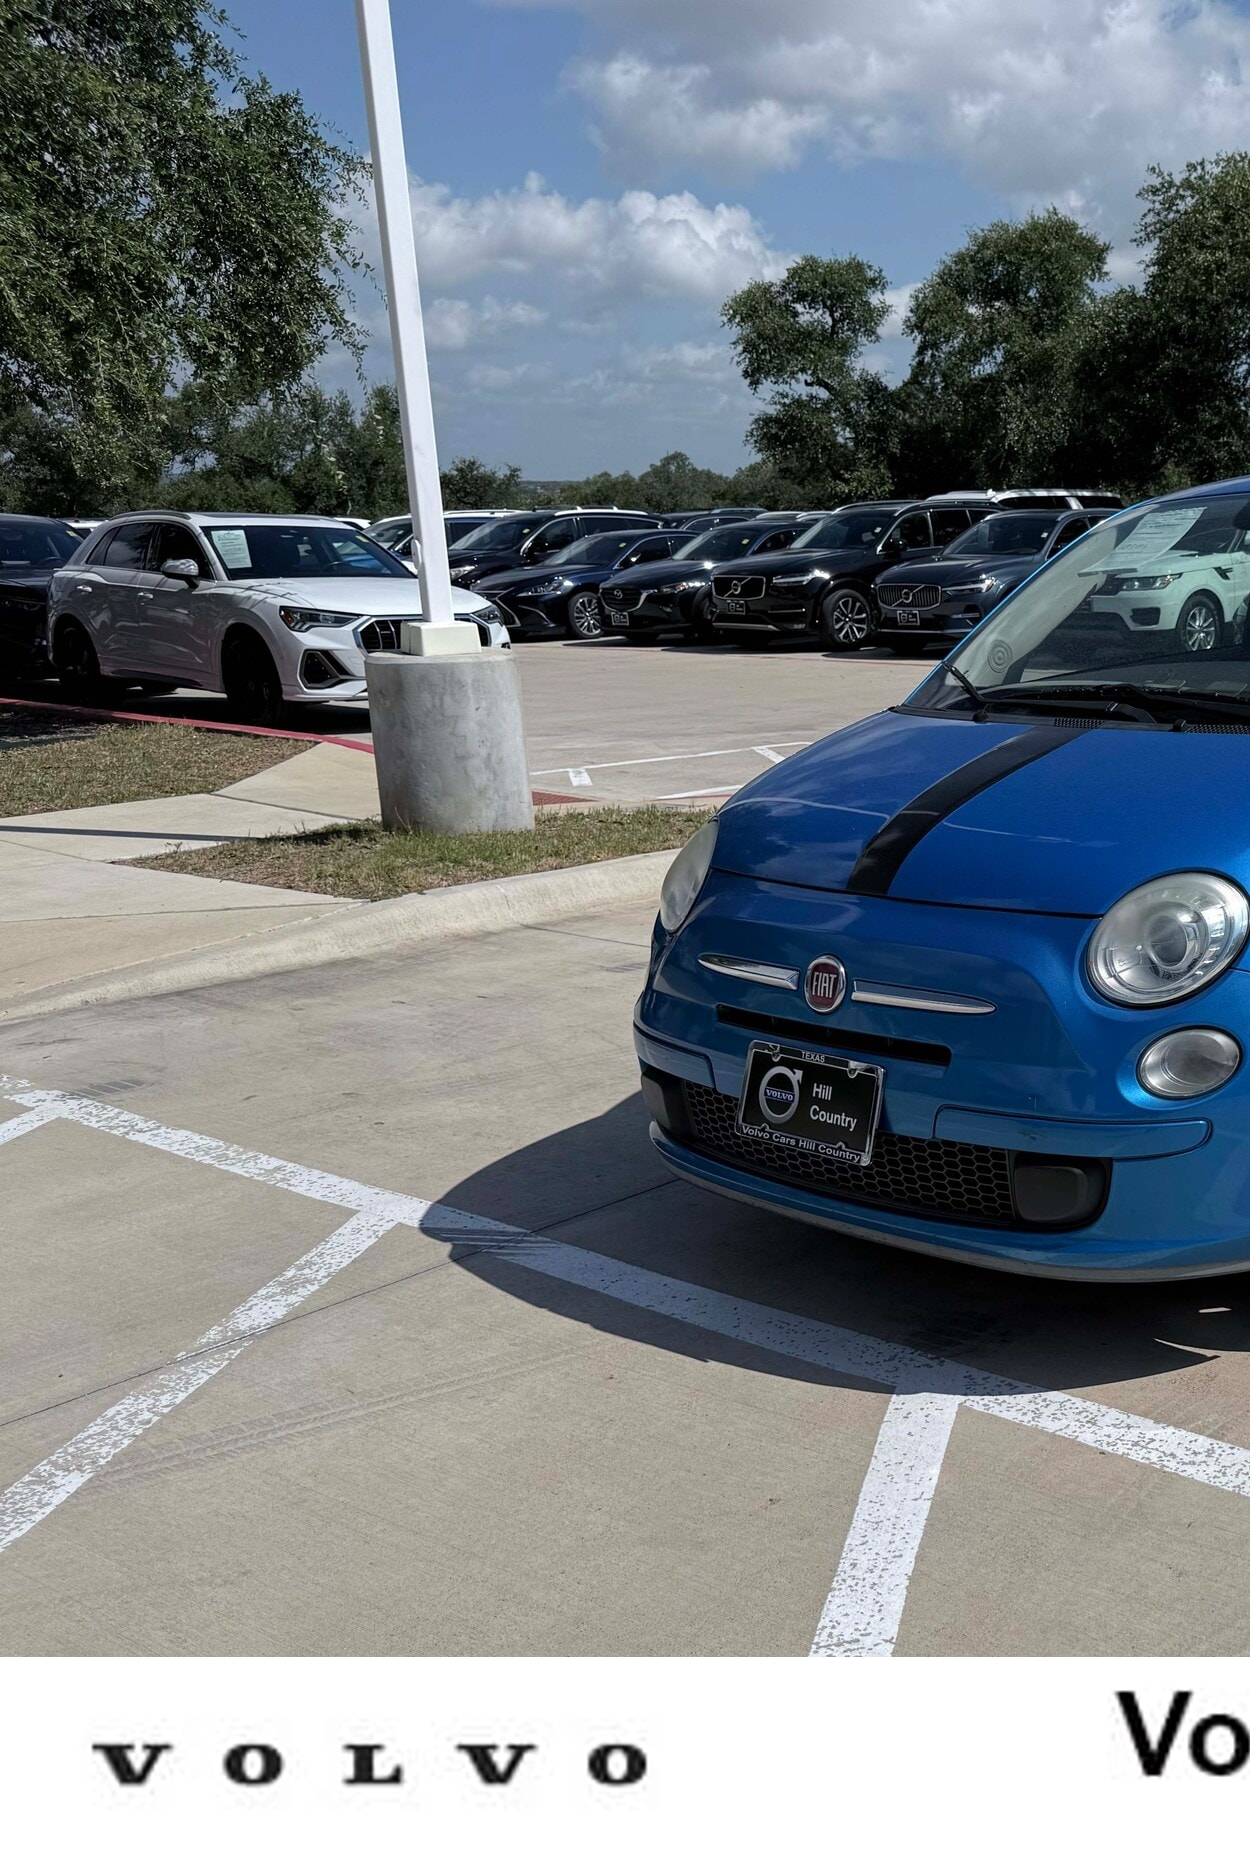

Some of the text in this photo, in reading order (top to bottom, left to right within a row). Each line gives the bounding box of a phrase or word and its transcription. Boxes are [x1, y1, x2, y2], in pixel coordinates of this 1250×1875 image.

[812, 972, 837, 998] FIAT
[802, 1051, 826, 1063] TEXAS
[765, 1088, 794, 1102] VOLVO
[812, 1082, 833, 1101] Hill
[809, 1104, 857, 1132] Country
[742, 1125, 861, 1162] Volvo Cars Hill Country
